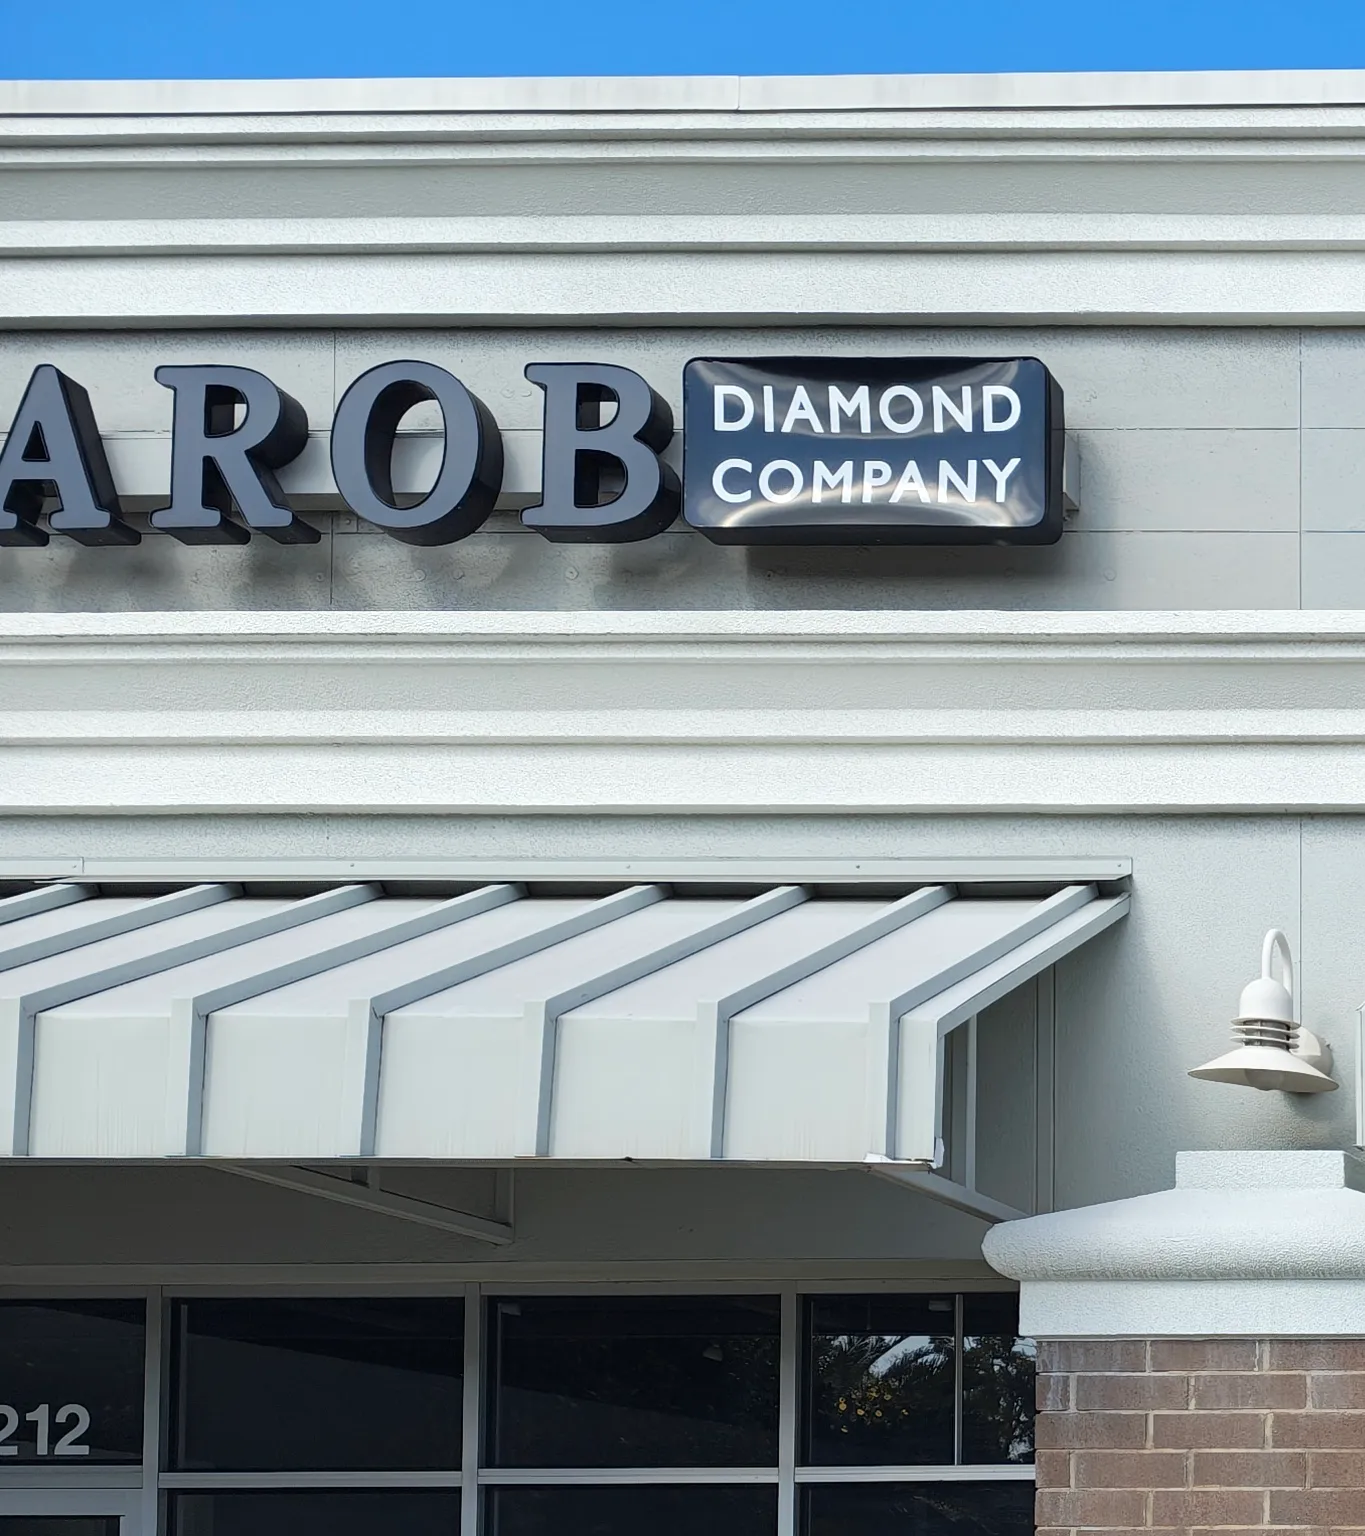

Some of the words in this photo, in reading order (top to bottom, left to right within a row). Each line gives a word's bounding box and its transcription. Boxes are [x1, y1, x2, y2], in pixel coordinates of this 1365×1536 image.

[712, 383, 1023, 434] DIAMOND
[0, 360, 684, 544] AROB
[710, 456, 1023, 505] COMPANY
